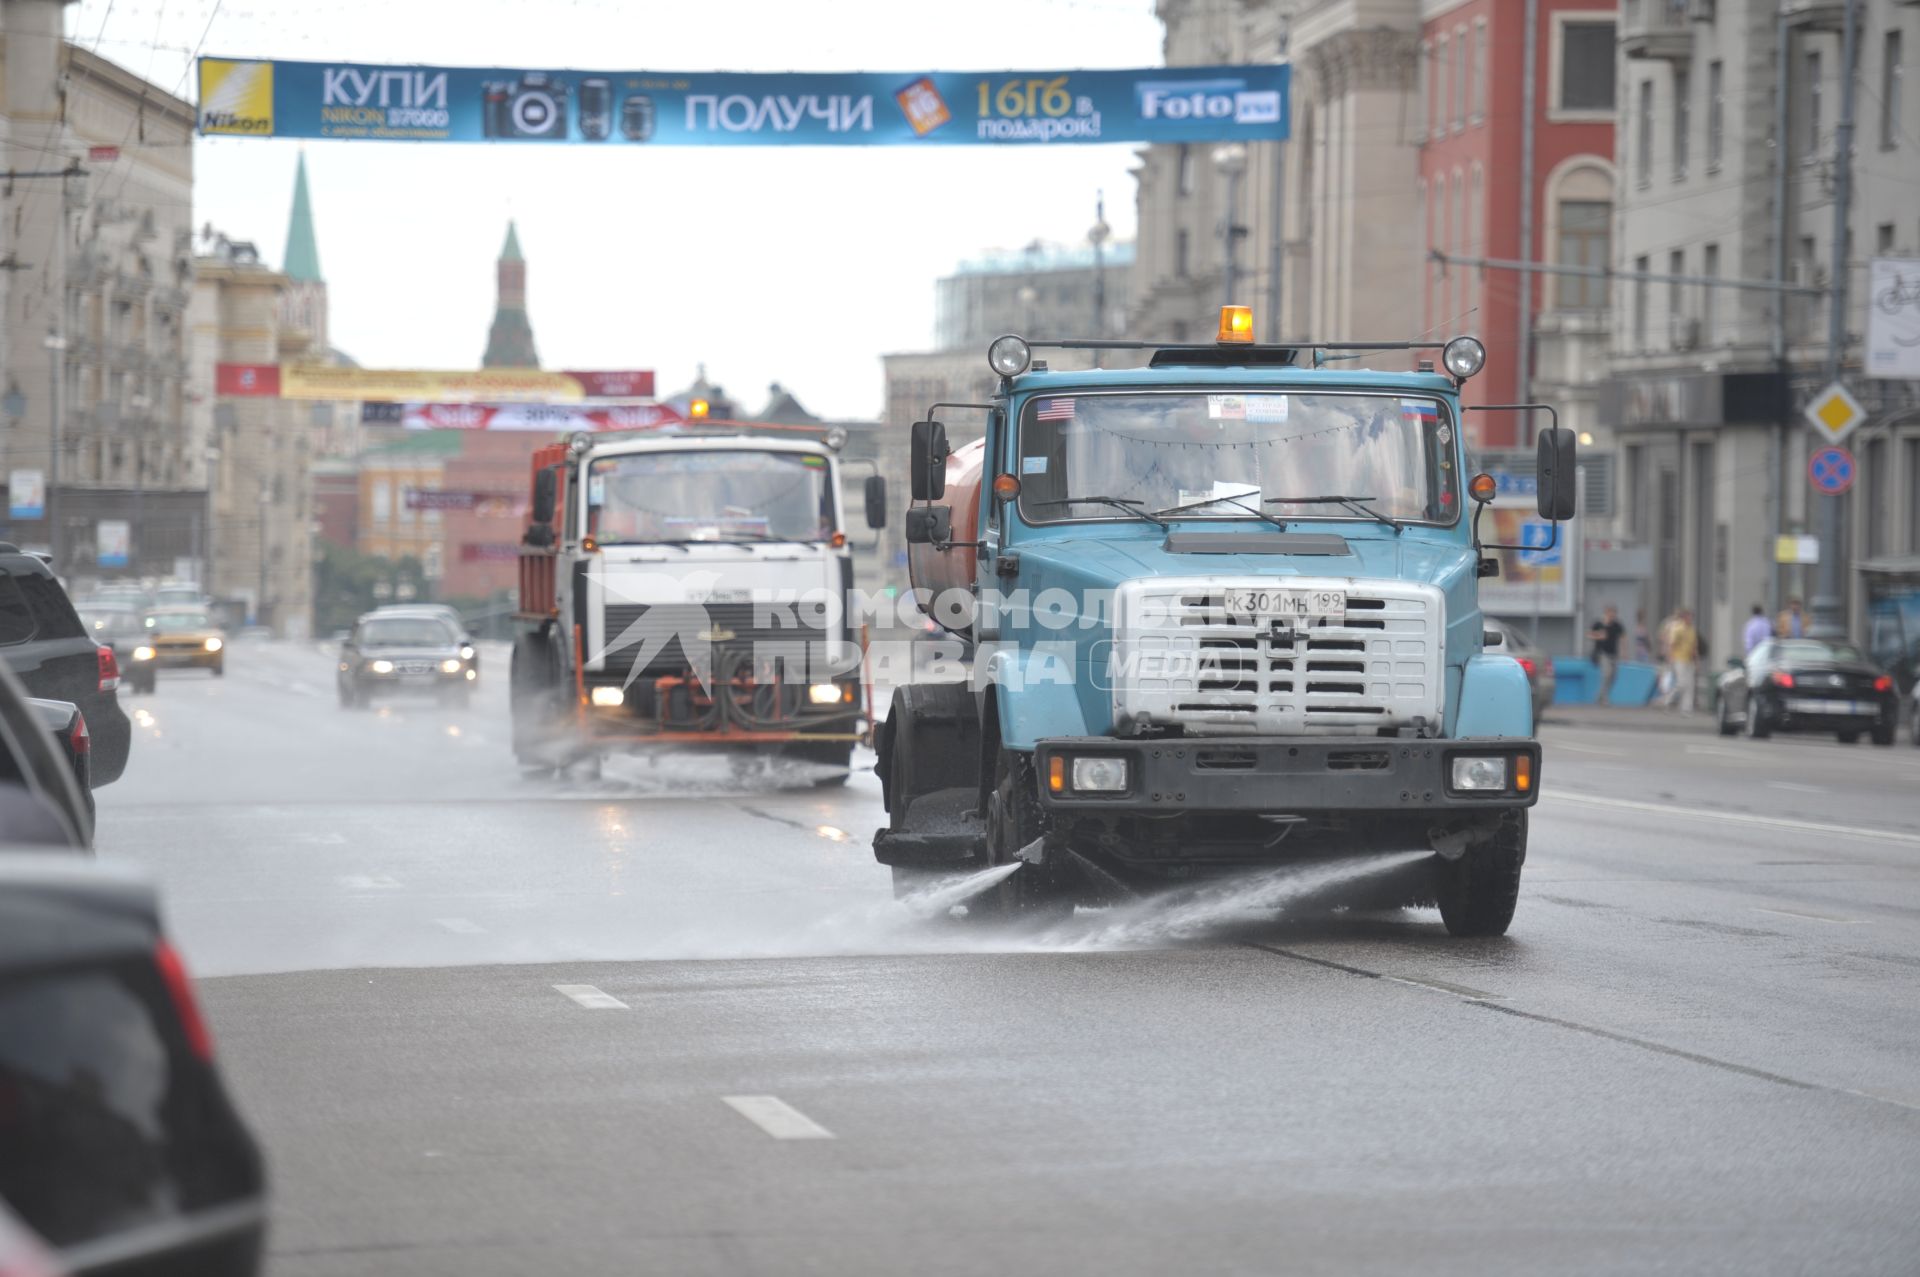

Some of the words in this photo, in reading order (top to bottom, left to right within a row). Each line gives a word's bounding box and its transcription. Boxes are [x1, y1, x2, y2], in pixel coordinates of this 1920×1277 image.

[323, 69, 448, 107] КУПИ
[976, 76, 1072, 118] 16Гб
[321, 108, 385, 126] NIKON
[685, 94, 874, 132] ПОЛУЧИ
[1141, 90, 1233, 119] Foto
[203, 111, 271, 131] Nikon
[977, 112, 1101, 141] подарок!
[1313, 593, 1341, 608] 199
